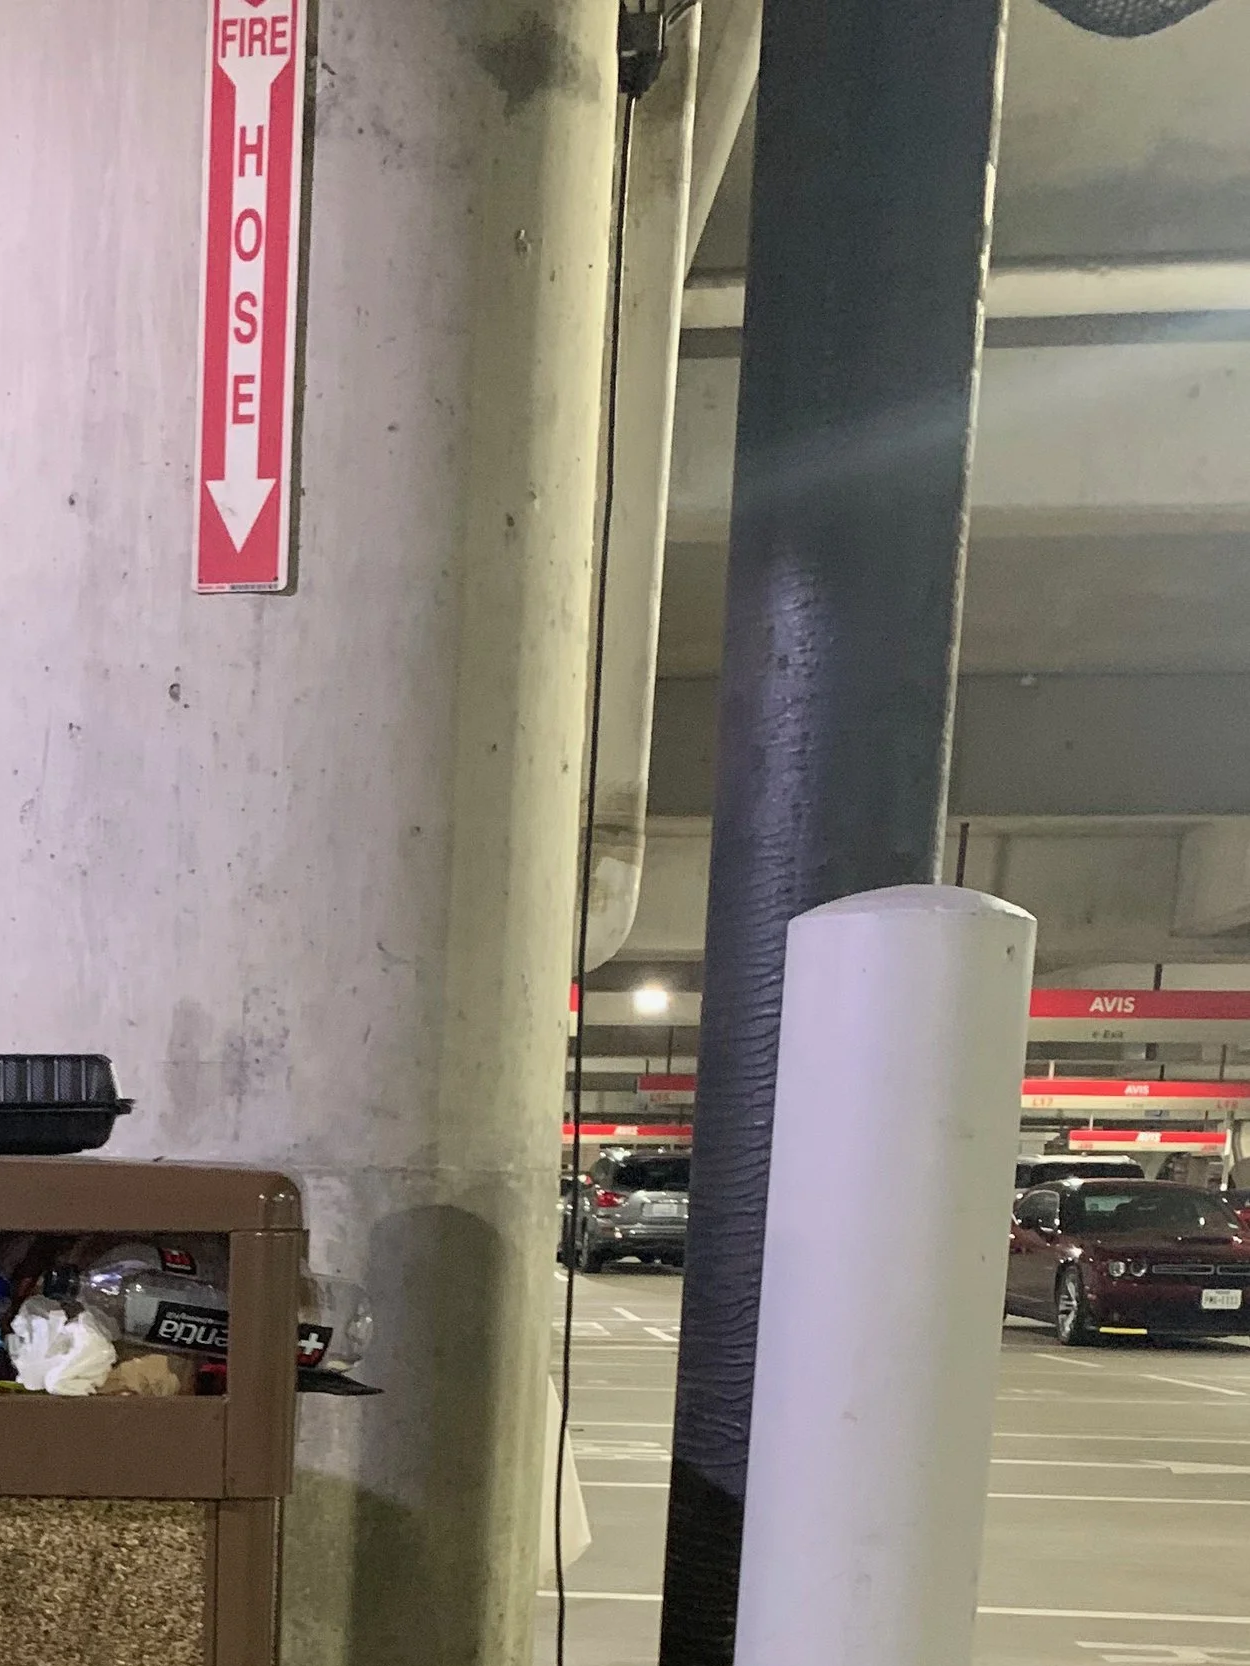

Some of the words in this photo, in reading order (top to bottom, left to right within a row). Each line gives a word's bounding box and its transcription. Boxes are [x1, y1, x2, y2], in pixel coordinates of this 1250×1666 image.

[221, 16, 288, 58] FIRE
[232, 124, 264, 425] HOSE
[1089, 996, 1136, 1013] AVIS
[1124, 1085, 1150, 1096] AVIS
